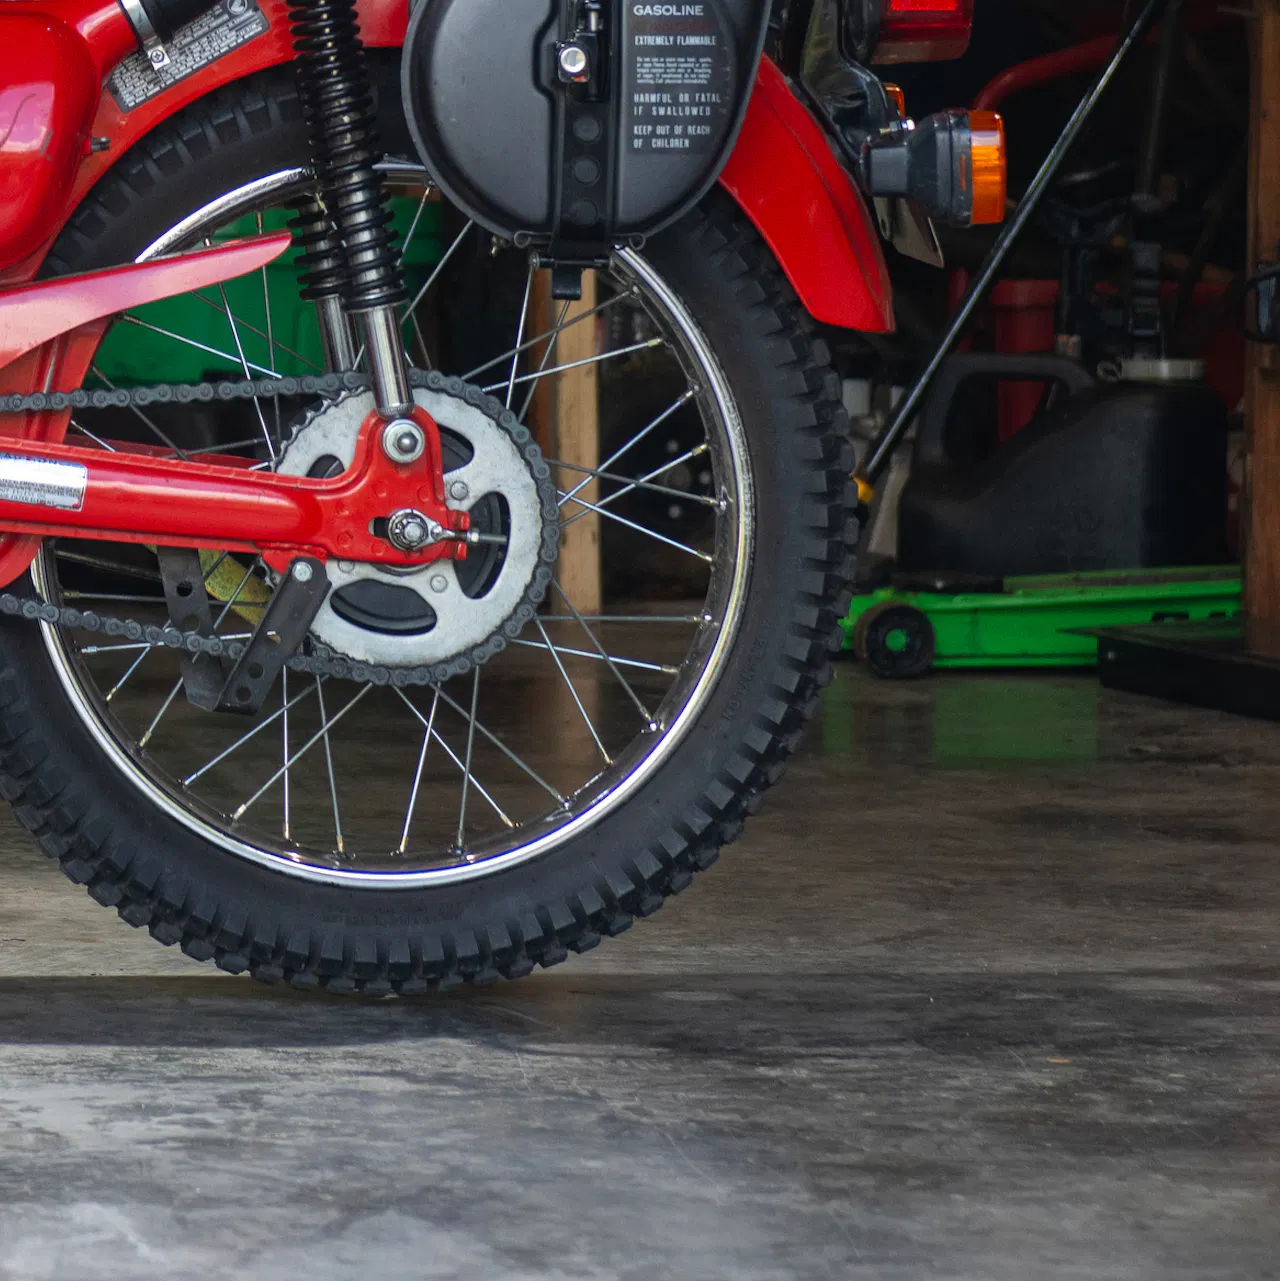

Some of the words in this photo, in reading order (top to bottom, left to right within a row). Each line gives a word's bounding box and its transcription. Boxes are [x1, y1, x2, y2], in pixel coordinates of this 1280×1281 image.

[633, 4, 705, 16] GASOLINE
[634, 35, 674, 46] EXTREMELY
[676, 35, 716, 46] FLAMMABLE
[633, 93, 672, 103] HARMFUL
[679, 93, 690, 103] OR
[695, 93, 721, 103] FATAL
[634, 106, 643, 116] IF
[651, 106, 711, 116] SWALLOWED
[633, 125, 652, 135] KEEP
[656, 125, 670, 135] OUT
[674, 125, 684, 135] OF
[687, 125, 711, 135] REACH
[633, 138, 643, 148] OF
[651, 138, 690, 148] CHILDREN
